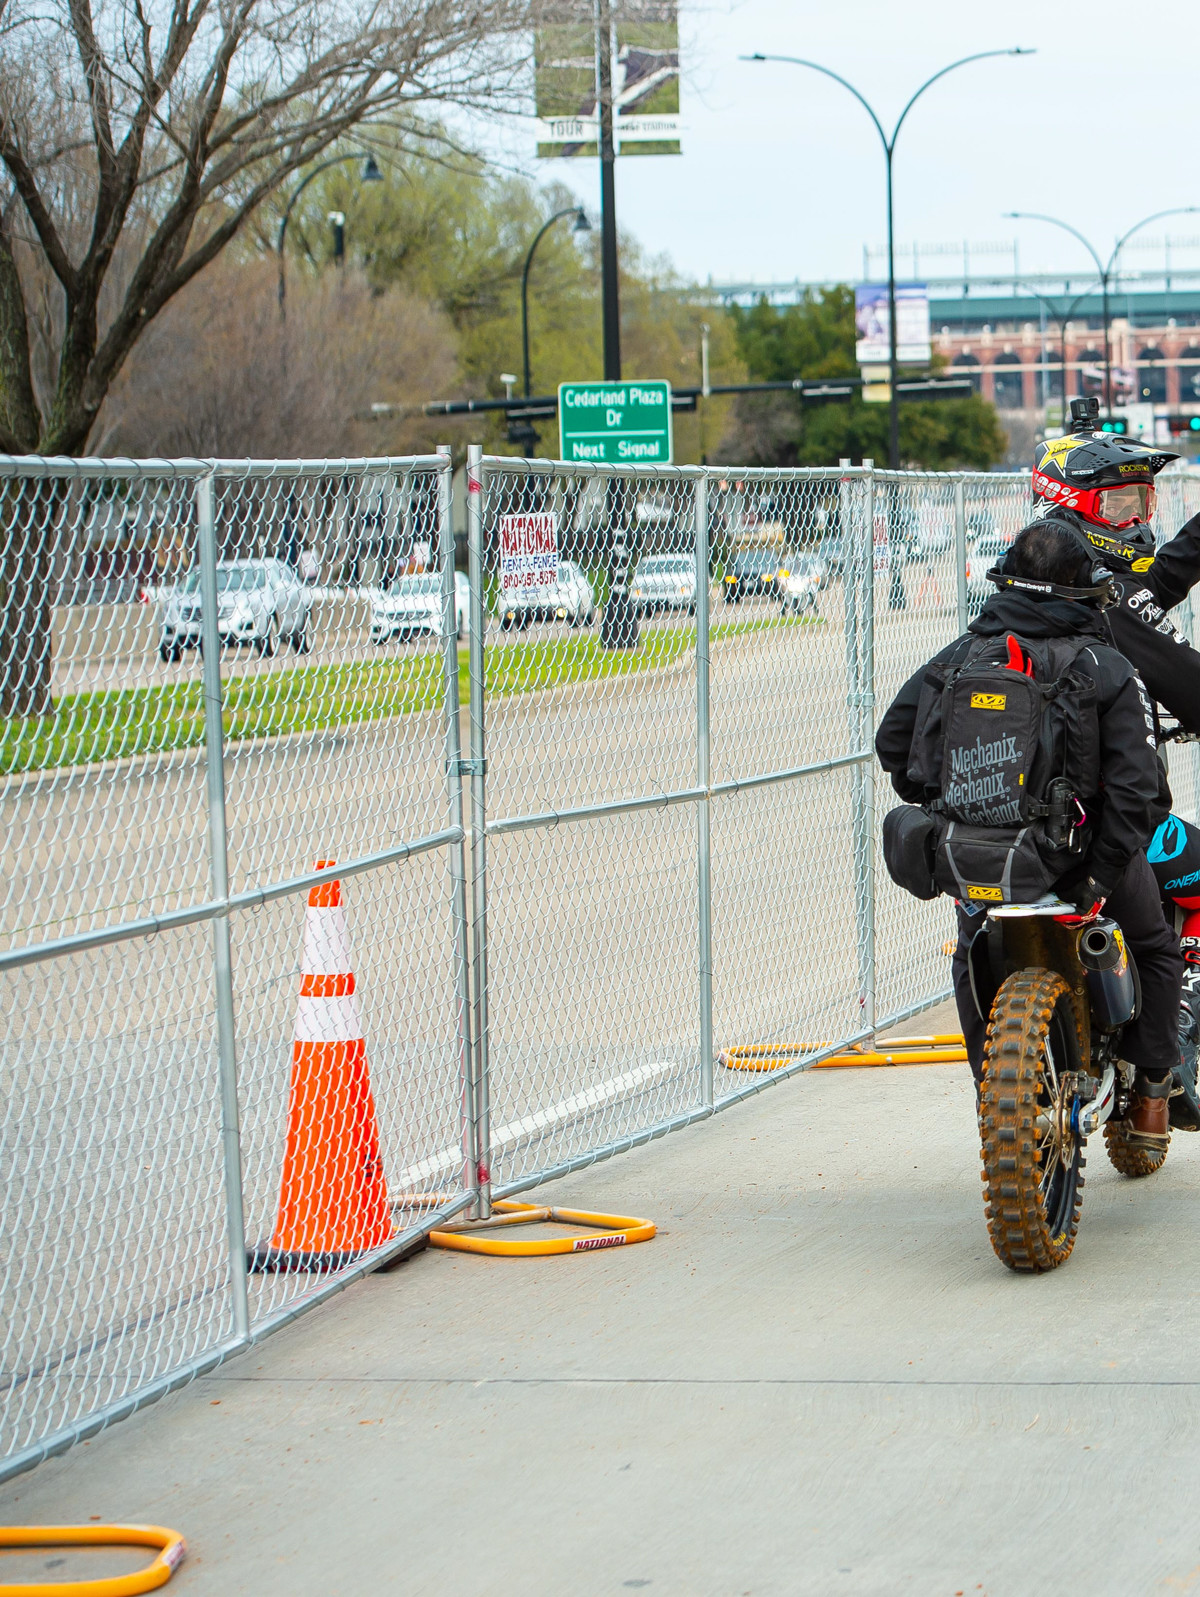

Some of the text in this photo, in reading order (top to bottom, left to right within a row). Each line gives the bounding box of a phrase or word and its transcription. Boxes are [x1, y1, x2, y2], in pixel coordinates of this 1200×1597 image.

[549, 121, 585, 137] TOUR
[564, 387, 664, 408] Cedarland Plaza
[606, 408, 623, 427] Dr
[572, 440, 660, 460] Next Signal
[501, 515, 557, 556] NATIONAL
[574, 1236, 625, 1250] NATIONAL
